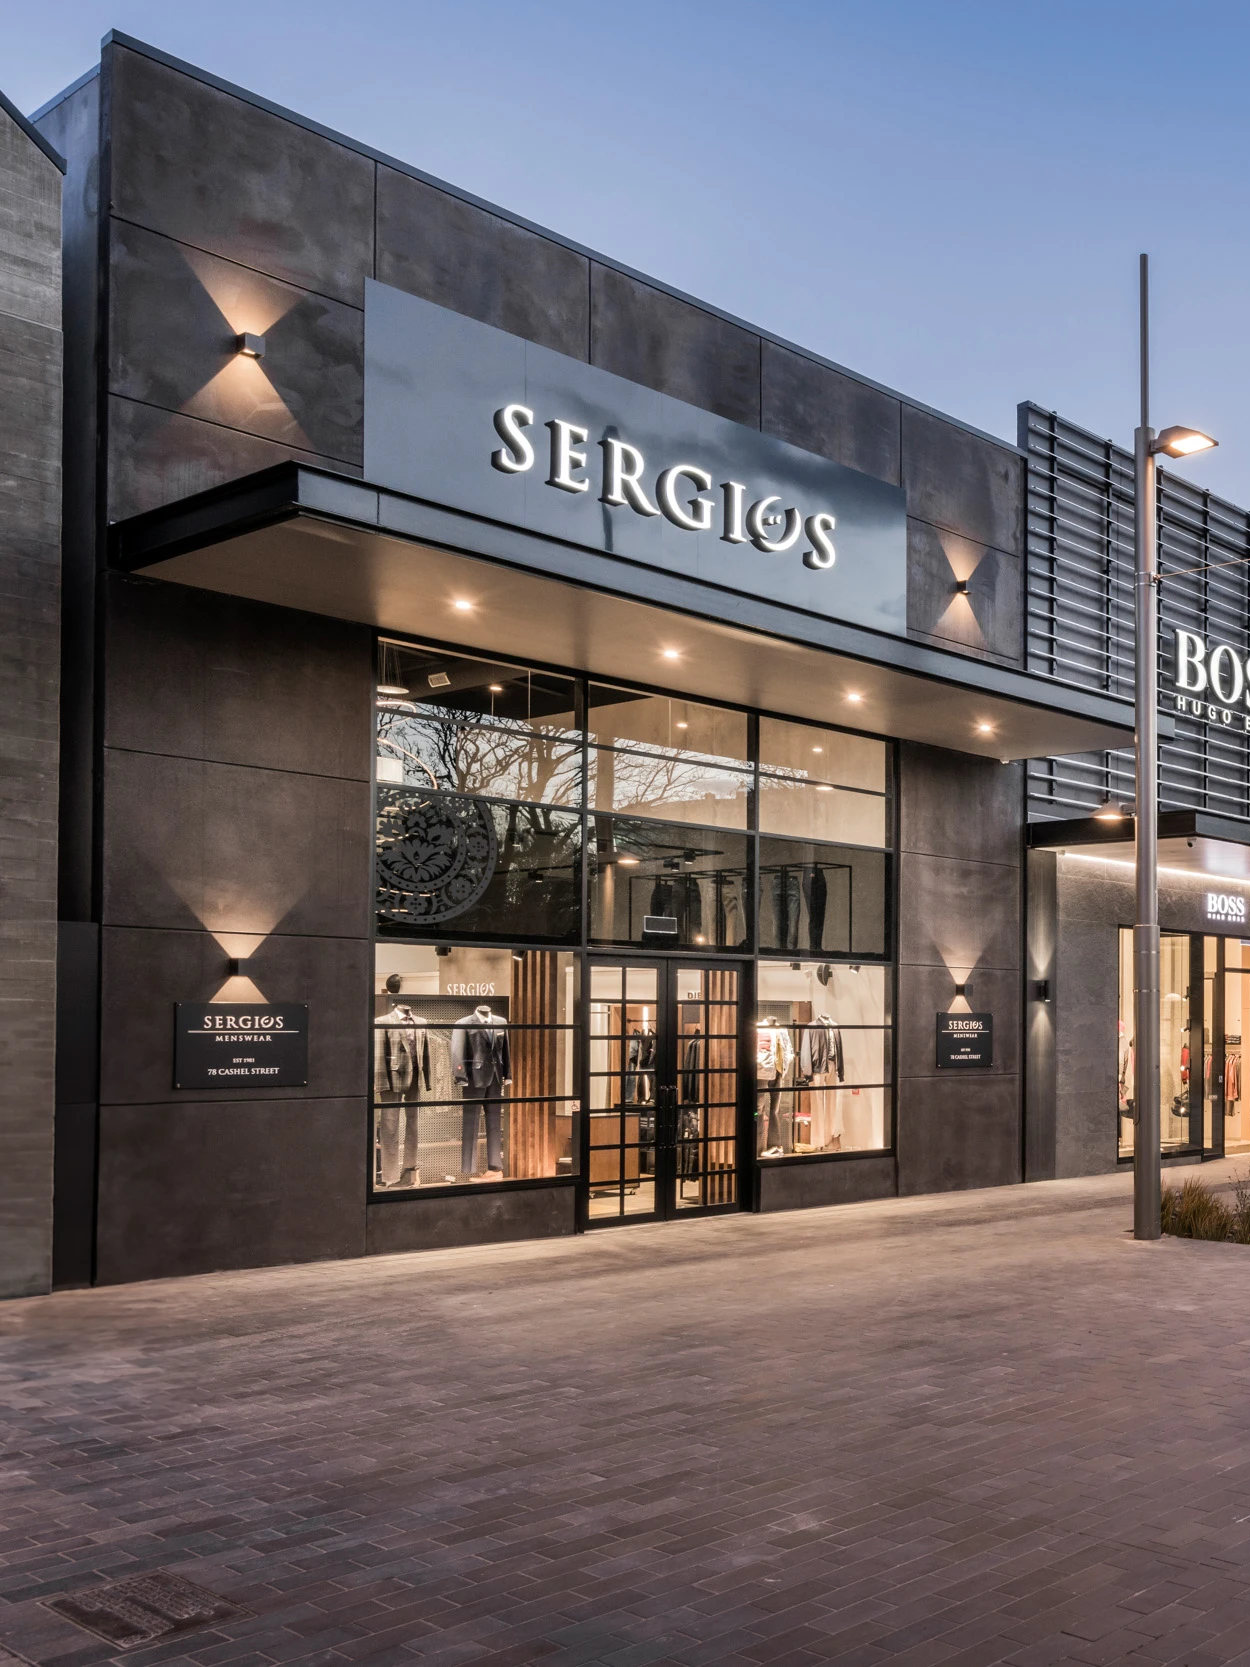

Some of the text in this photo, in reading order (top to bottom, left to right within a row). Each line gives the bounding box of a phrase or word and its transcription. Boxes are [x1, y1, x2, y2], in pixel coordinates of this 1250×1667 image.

[491, 403, 837, 571] SERGIOS
[1176, 694, 1232, 724] HUGO
[1207, 893, 1245, 915] BOSS
[446, 982, 495, 996] SERGIOS
[203, 1015, 284, 1029] SERGIOS
[948, 1020, 983, 1030] SERGIOS
[207, 1067, 280, 1076] 78 CASHEL STREET
